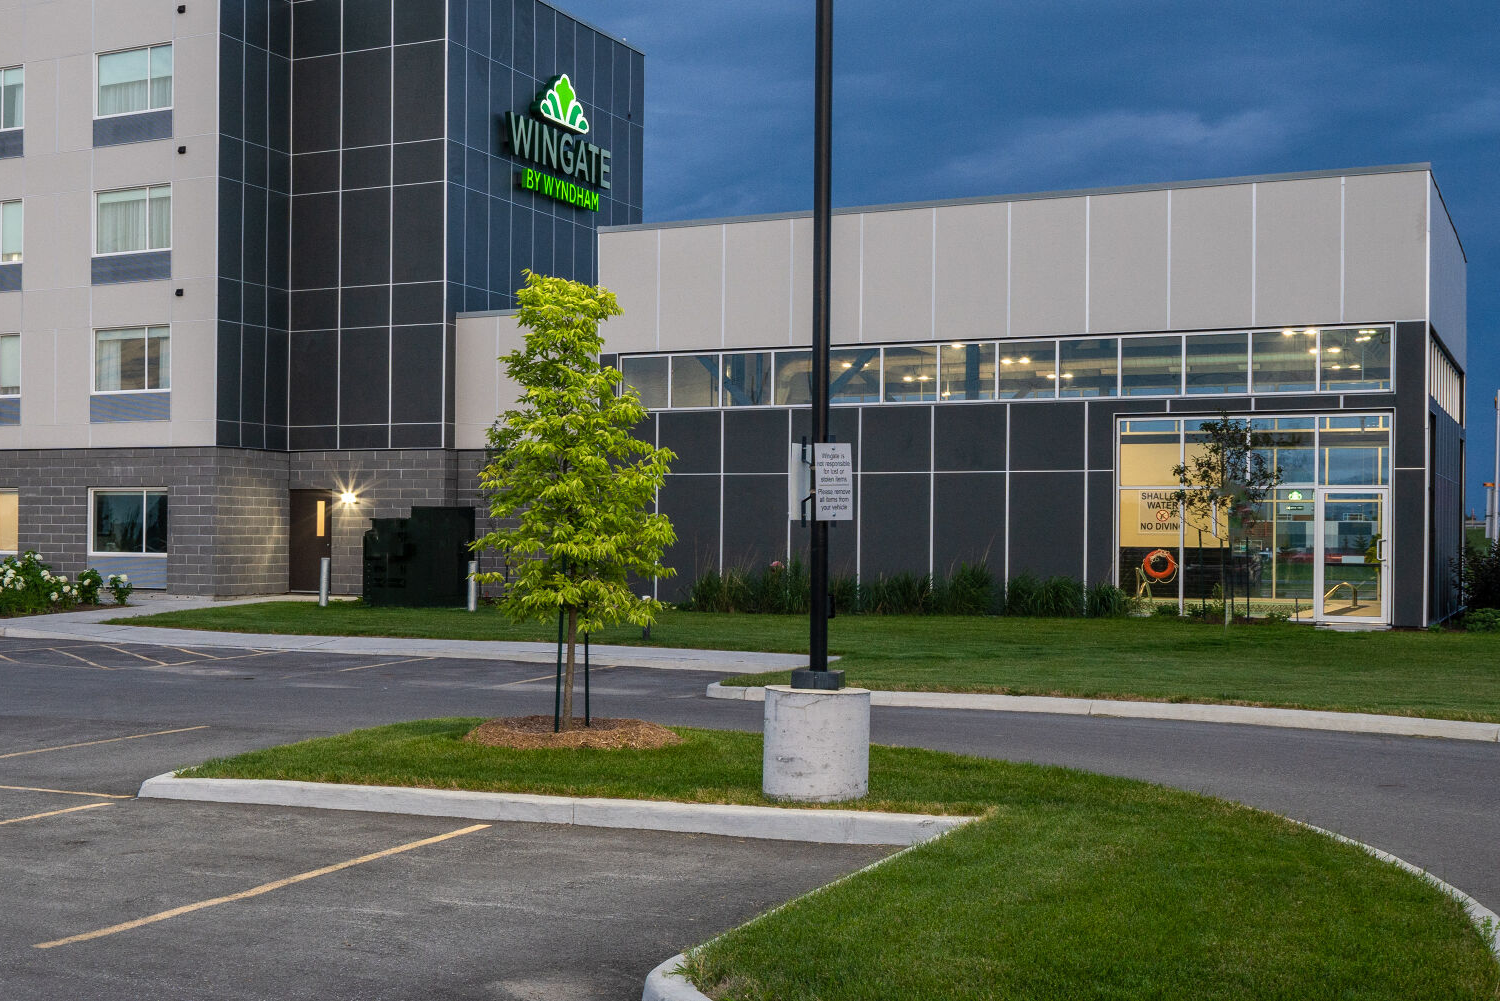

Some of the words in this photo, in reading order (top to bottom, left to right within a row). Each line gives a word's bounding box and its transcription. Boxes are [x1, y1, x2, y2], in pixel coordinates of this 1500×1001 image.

[507, 111, 611, 190] WINGATE
[524, 167, 541, 191] BY
[543, 175, 599, 212] WYNDHAM
[1141, 492, 1179, 501] SHALLO
[1147, 501, 1179, 510] WATER
[1140, 522, 1153, 530] NO
[1155, 522, 1180, 531] DIVIN
